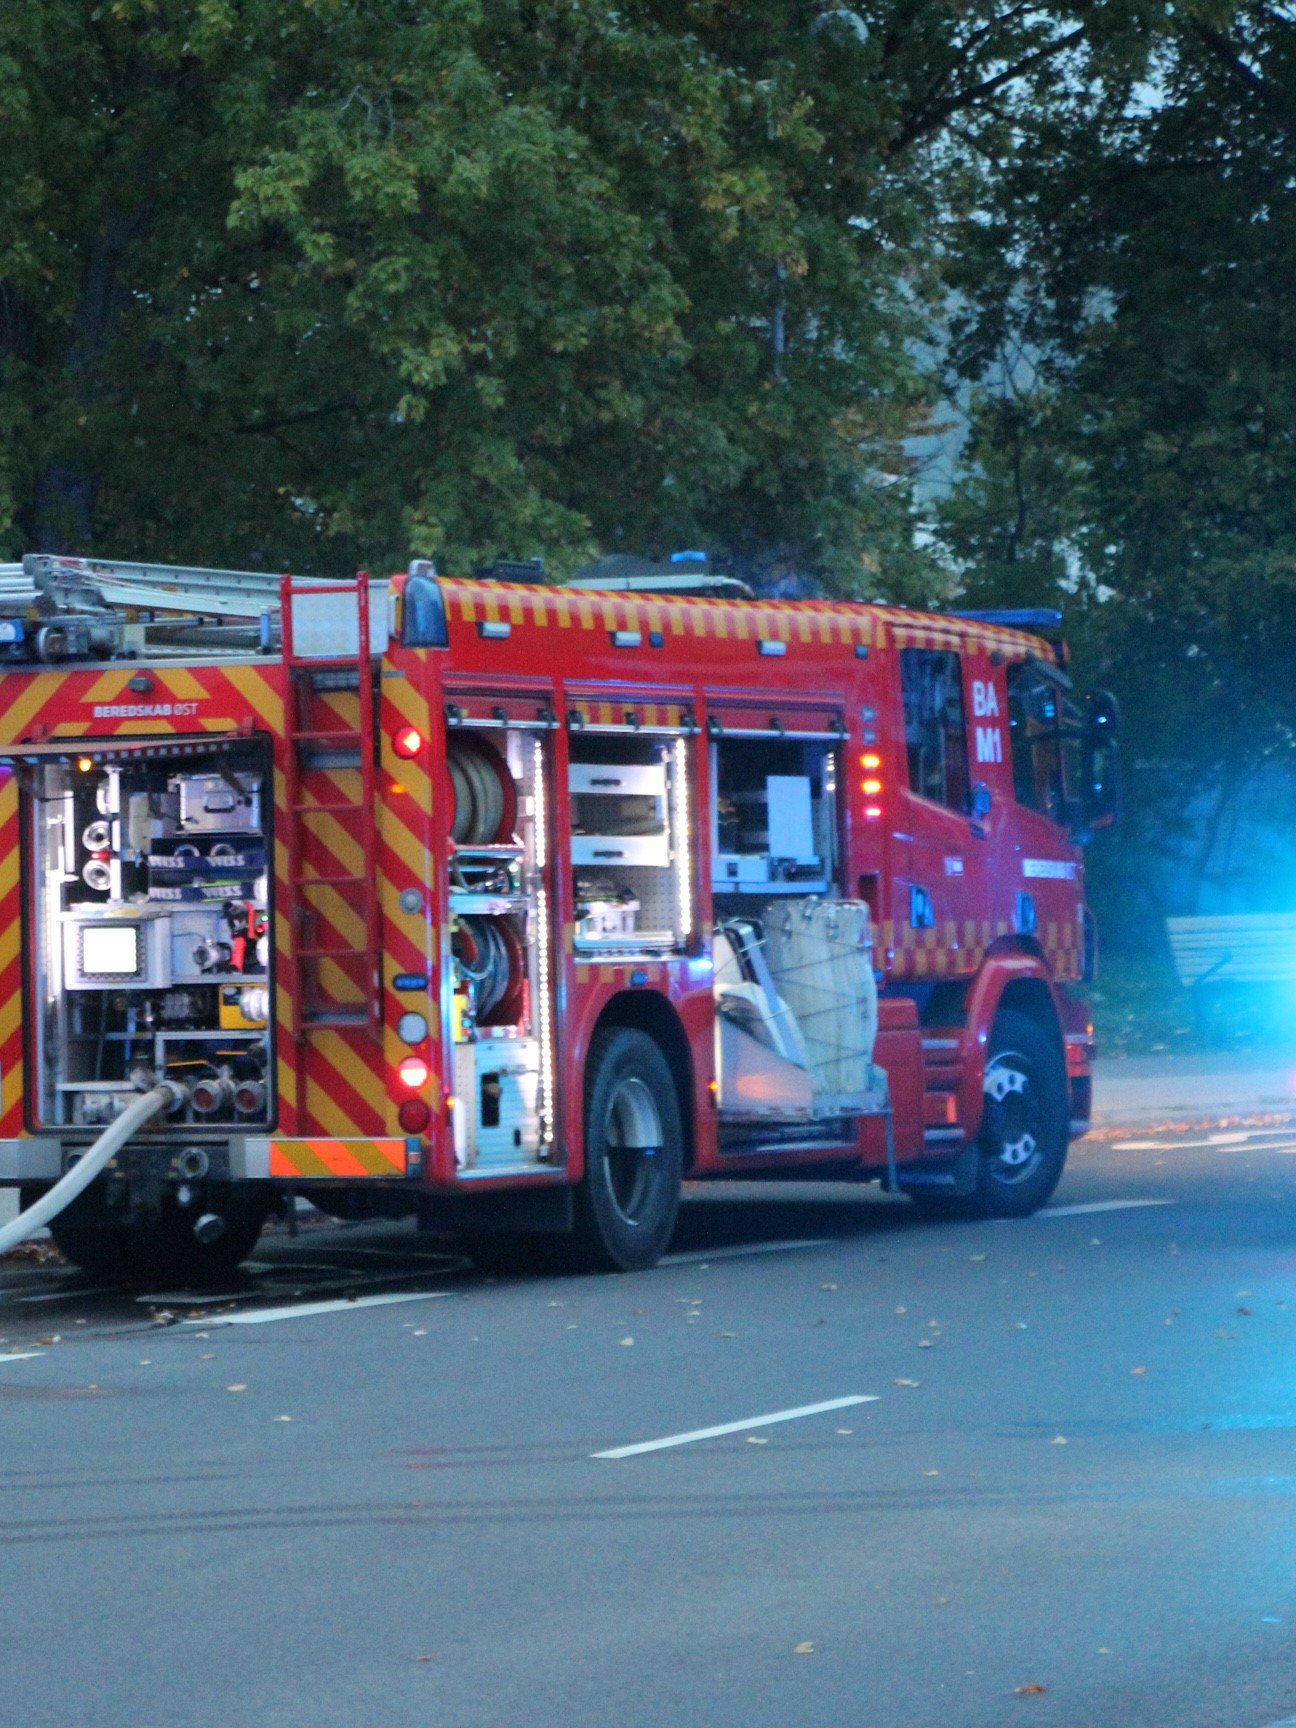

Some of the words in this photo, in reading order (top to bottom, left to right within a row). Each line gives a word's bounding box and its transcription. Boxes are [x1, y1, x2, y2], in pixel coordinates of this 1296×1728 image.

[94, 704, 172, 718] BEREDSKAB
[173, 703, 199, 715] ØST
[973, 681, 1000, 717] BA
[976, 727, 1002, 763] M1
